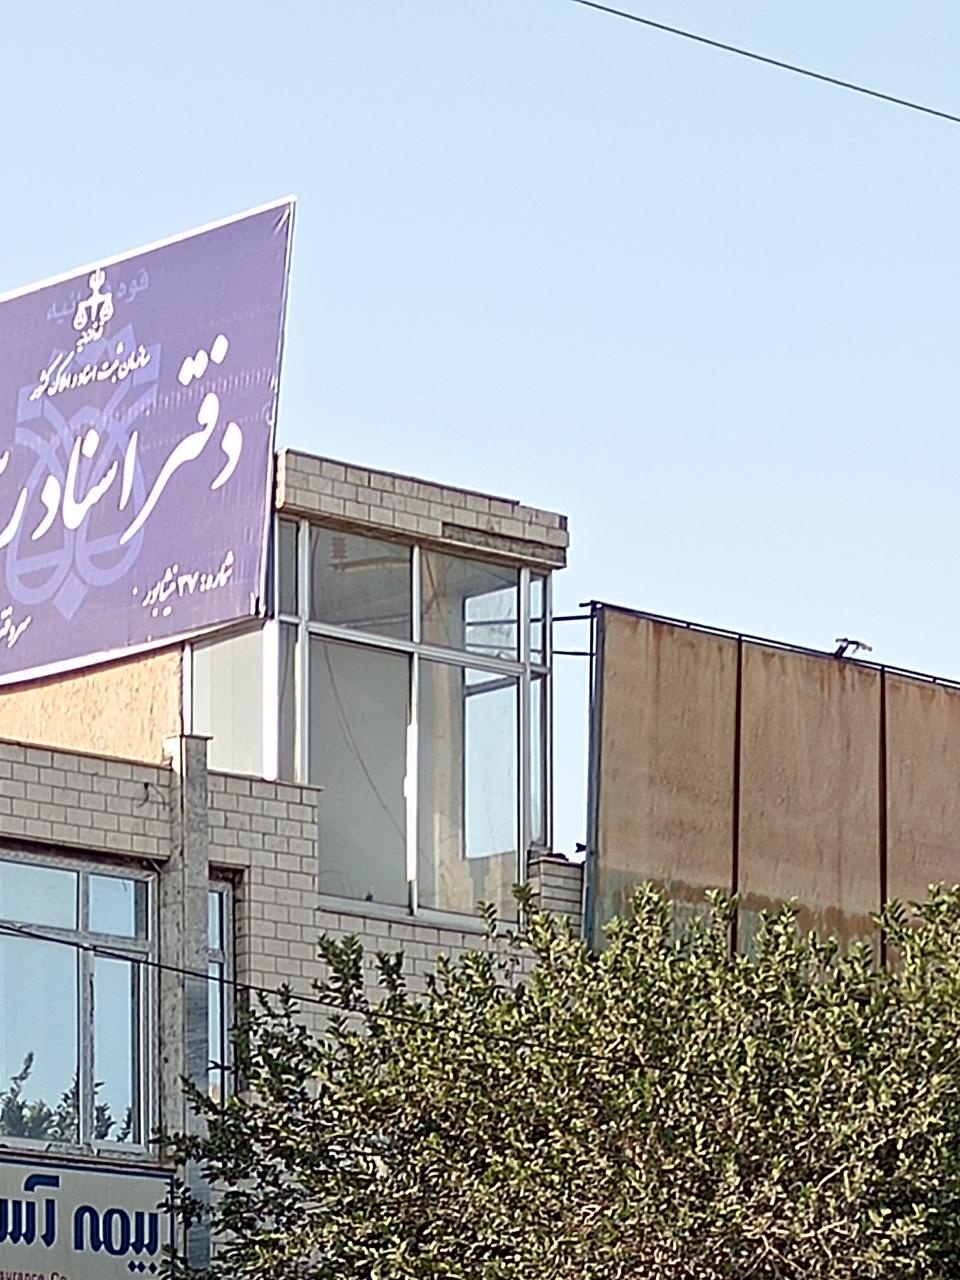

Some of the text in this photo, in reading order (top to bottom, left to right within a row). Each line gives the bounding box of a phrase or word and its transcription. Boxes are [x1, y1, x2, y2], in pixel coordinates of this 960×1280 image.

[31, 429, 138, 541] اسناد
[119, 334, 243, 545] دفتر
[73, 1203, 160, 1275] بیمه
